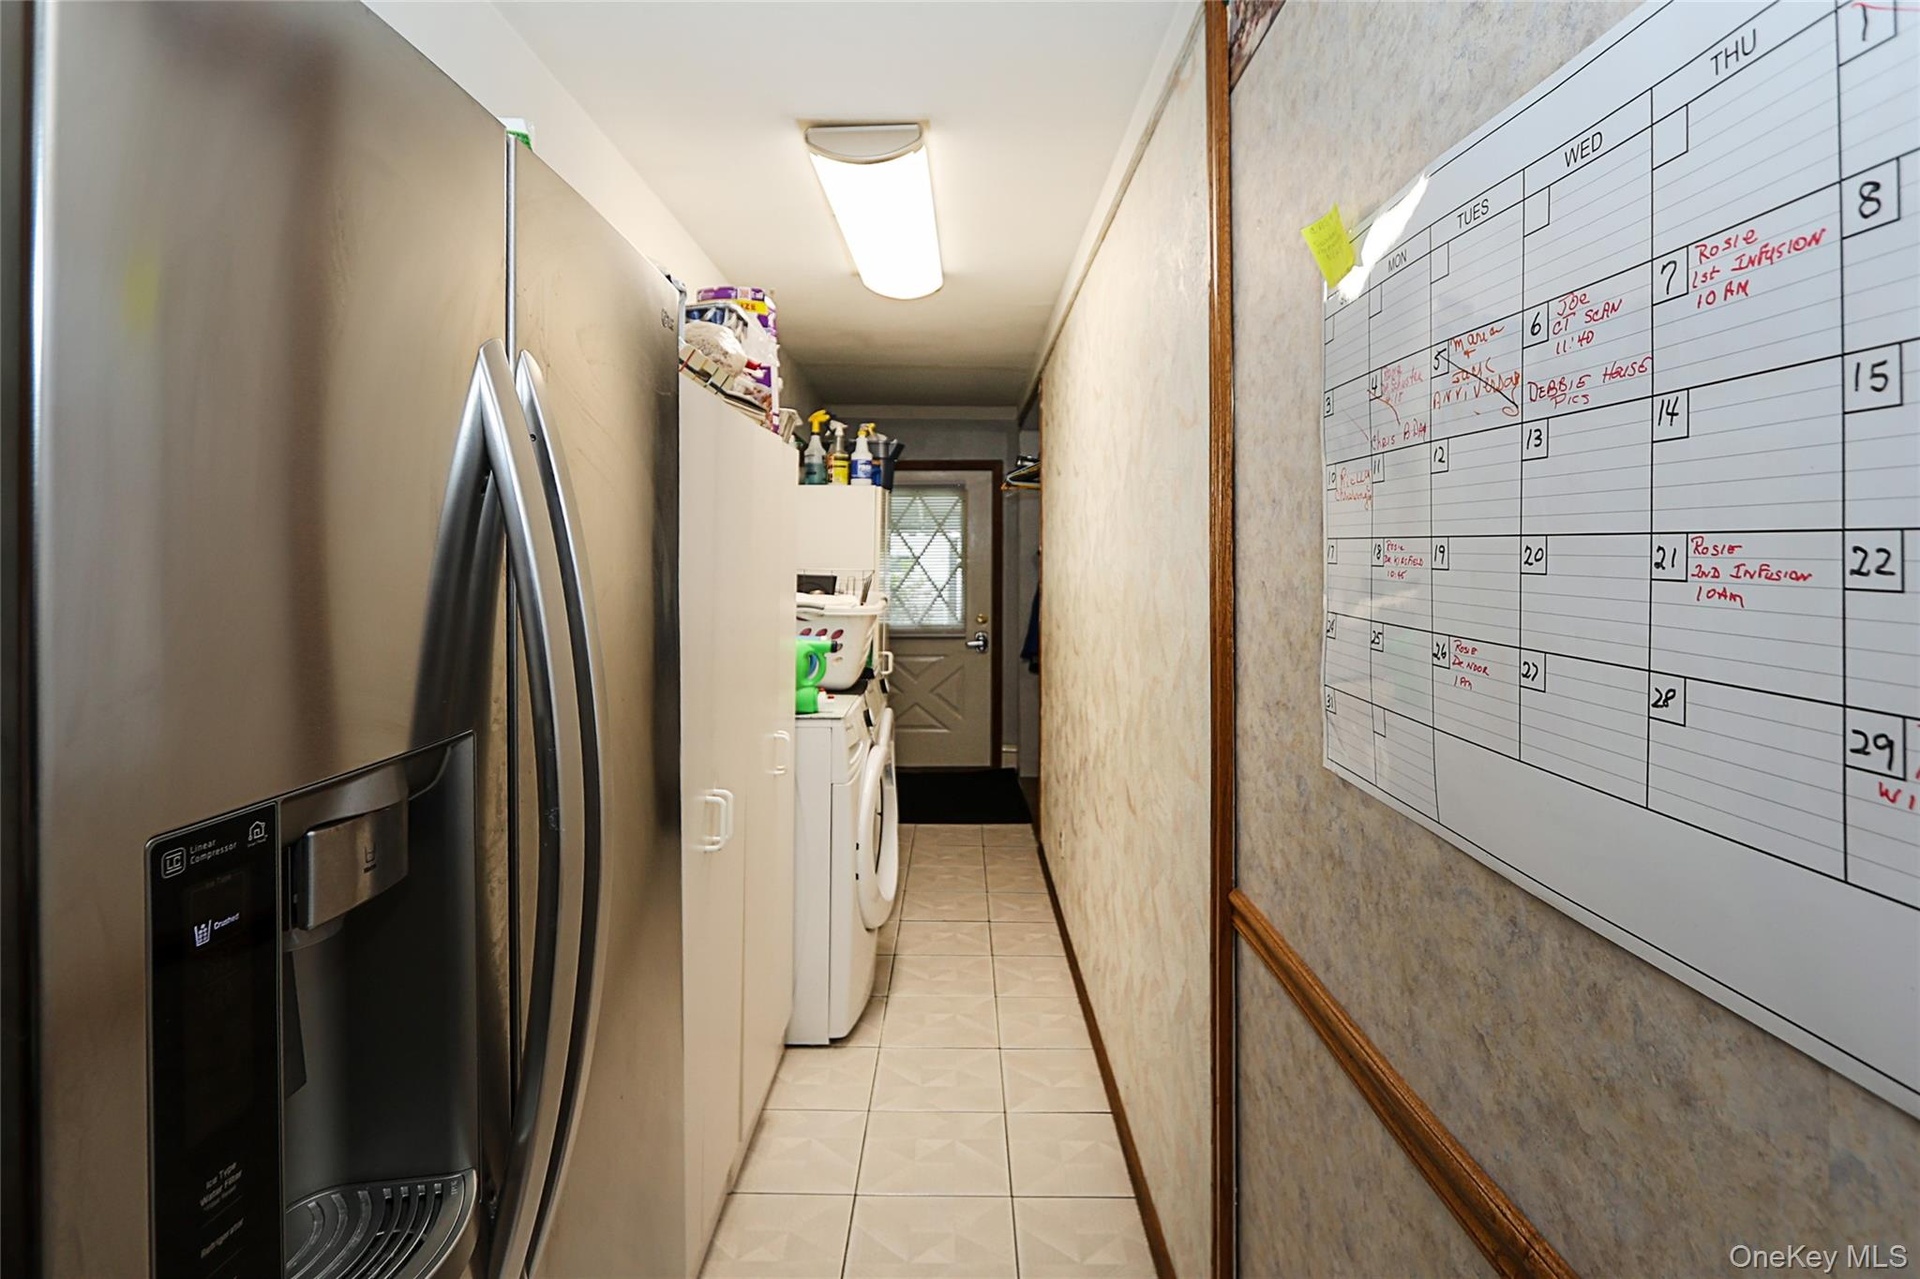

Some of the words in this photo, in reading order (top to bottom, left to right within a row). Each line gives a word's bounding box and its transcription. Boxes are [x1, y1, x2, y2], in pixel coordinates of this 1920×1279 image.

[1710, 28, 1757, 76] THU
[1564, 131, 1604, 168] WED
[1858, 181, 1881, 219] 8
[1457, 199, 1490, 230] TUES
[1388, 250, 1408, 273] MON
[1660, 260, 1678, 295] 7
[1697, 288, 1717, 309] 10
[1723, 279, 1750, 303] AM
[1530, 312, 1542, 337] 6
[1552, 312, 1576, 336] CT
[1584, 299, 1623, 326] SCAN
[1433, 348, 1447, 371] 5
[1371, 375, 1378, 395] 4
[1854, 360, 1890, 394] 15
[1657, 396, 1680, 428] 14
[1526, 430, 1542, 450] 13
[1433, 446, 1446, 463] 12
[1373, 458, 1381, 475] 11
[1328, 471, 1336, 485] 10
[1327, 545, 1334, 559] 17
[1373, 543, 1382, 560] 18
[1433, 545, 1445, 565] 19
[1524, 546, 1544, 567] 20
[1654, 546, 1676, 570] 21
[1850, 546, 1896, 577] 22
[1690, 564, 1722, 580] 2ND
[1371, 631, 1382, 645] 25
[1432, 641, 1447, 661] 26
[1521, 661, 1539, 682] 27
[1326, 693, 1334, 709] 31
[1651, 687, 1677, 708] 28
[1850, 729, 1895, 771] 29
[189, 839, 217, 854] Linear
[189, 842, 237, 865] Compressor
[213, 912, 240, 931] Crushed
